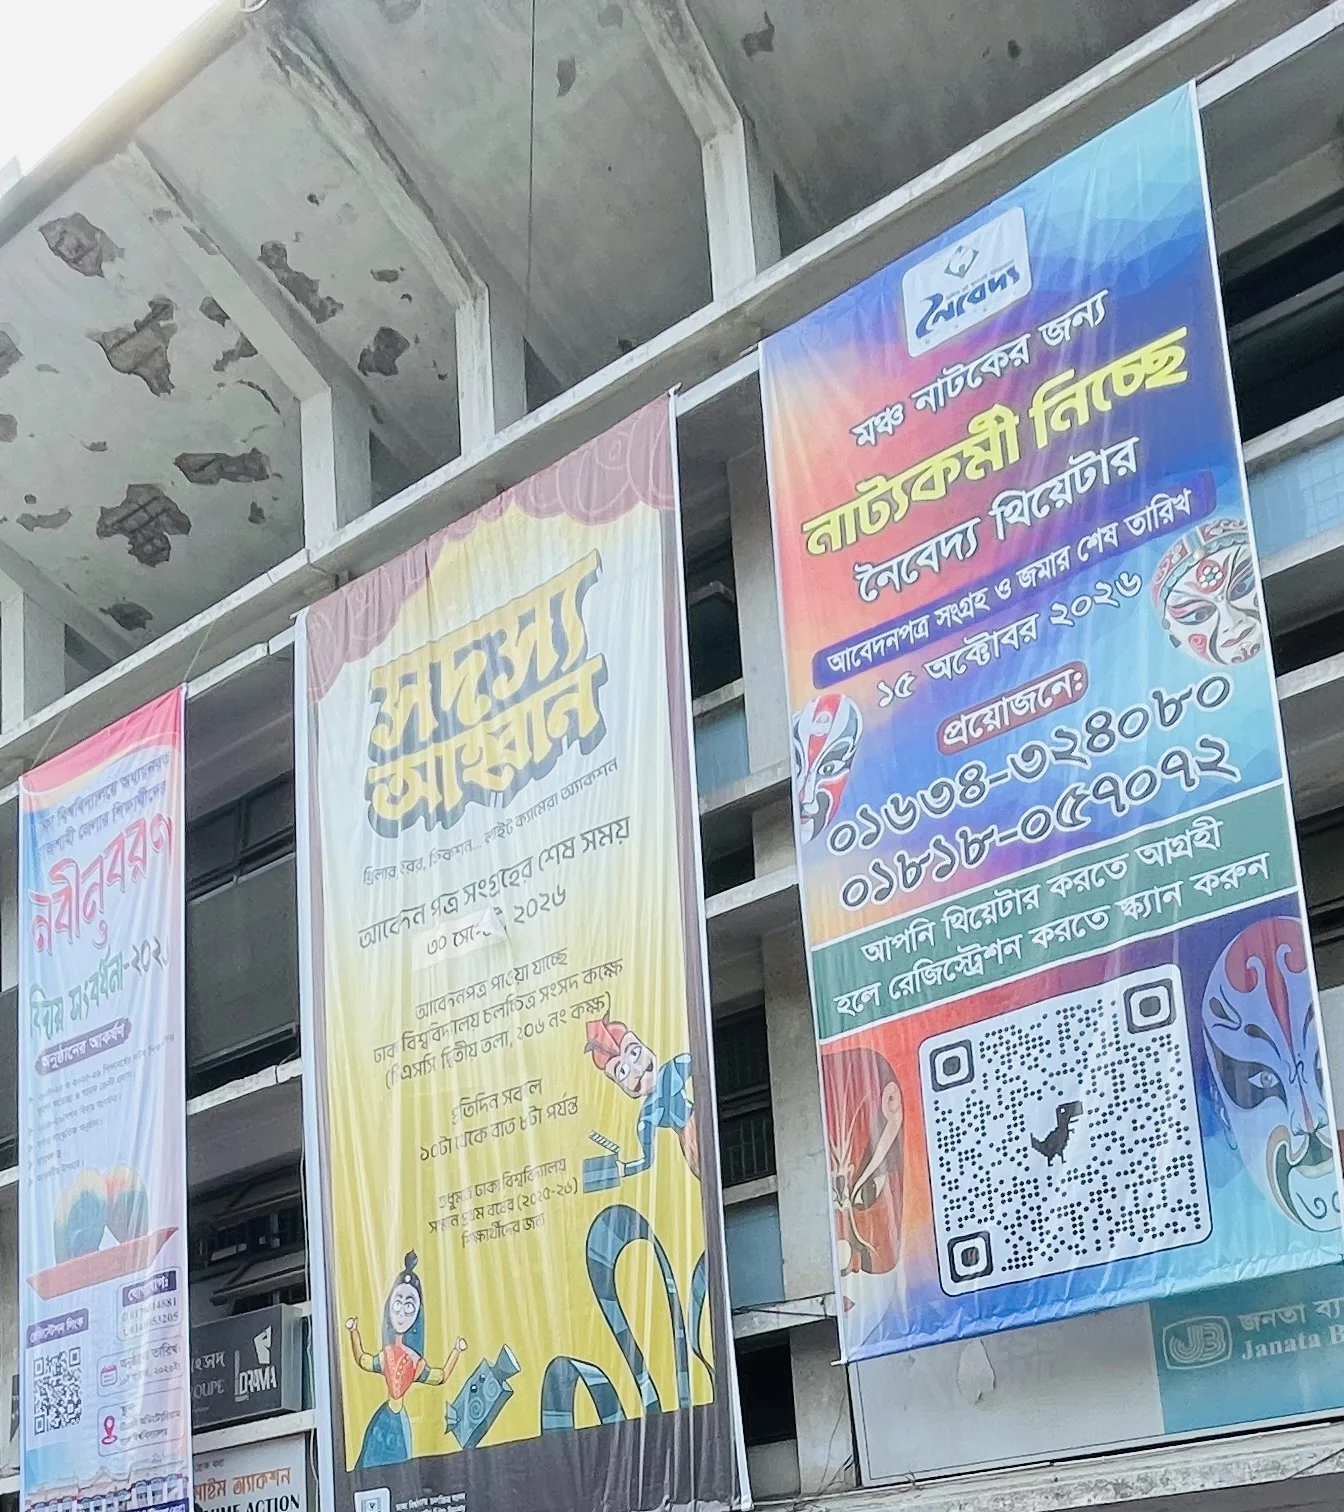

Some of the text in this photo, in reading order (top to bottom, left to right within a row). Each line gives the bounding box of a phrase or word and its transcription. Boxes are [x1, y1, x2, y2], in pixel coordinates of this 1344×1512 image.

[915, 265, 1021, 340] নৈবেদ্য
[851, 288, 1110, 447] মঞ্চ নাটকের জন্য
[802, 326, 1190, 557] নাট্যকর্মী নিচ্ছে
[853, 436, 1140, 603] নৈবেদ্য থিয়েটার
[824, 487, 1194, 674] আবেদনপত্র সংগ্রহ ও জমার শেষ তারিখ
[876, 571, 1143, 709] ১৫ অক্টোবর ২০২৬
[515, 795, 560, 829] ক্যামেরা
[560, 756, 620, 801] অ্যাকশন
[827, 674, 1233, 854] ০১৬৩৪-৩২৪০৮০
[839, 734, 1241, 909] ০১৮১৮-০৫৭০৭২
[430, 890, 460, 921] পত্র
[462, 856, 534, 908] সংগ্রহের
[538, 834, 576, 872] শেষ
[580, 815, 632, 854] সময়
[860, 816, 1225, 965] আপনি থিয়েটার করতে আগ্রহী
[531, 947, 569, 977] যাচ্ছে
[832, 851, 1272, 1018] হলে রেজিস্ট্রেশন করতে স্ক্যান করুন
[539, 970, 580, 1004] সংসদ
[581, 956, 625, 985] কক্ষে
[548, 1008, 568, 1029] নং
[473, 1178, 500, 1199] ঢাকা
[1237, 1302, 1308, 1333] জনতা
[1240, 1333, 1322, 1362] Janata
[239, 1365, 278, 1395] DRAMA
[231, 1466, 292, 1497] অ্যাকশন
